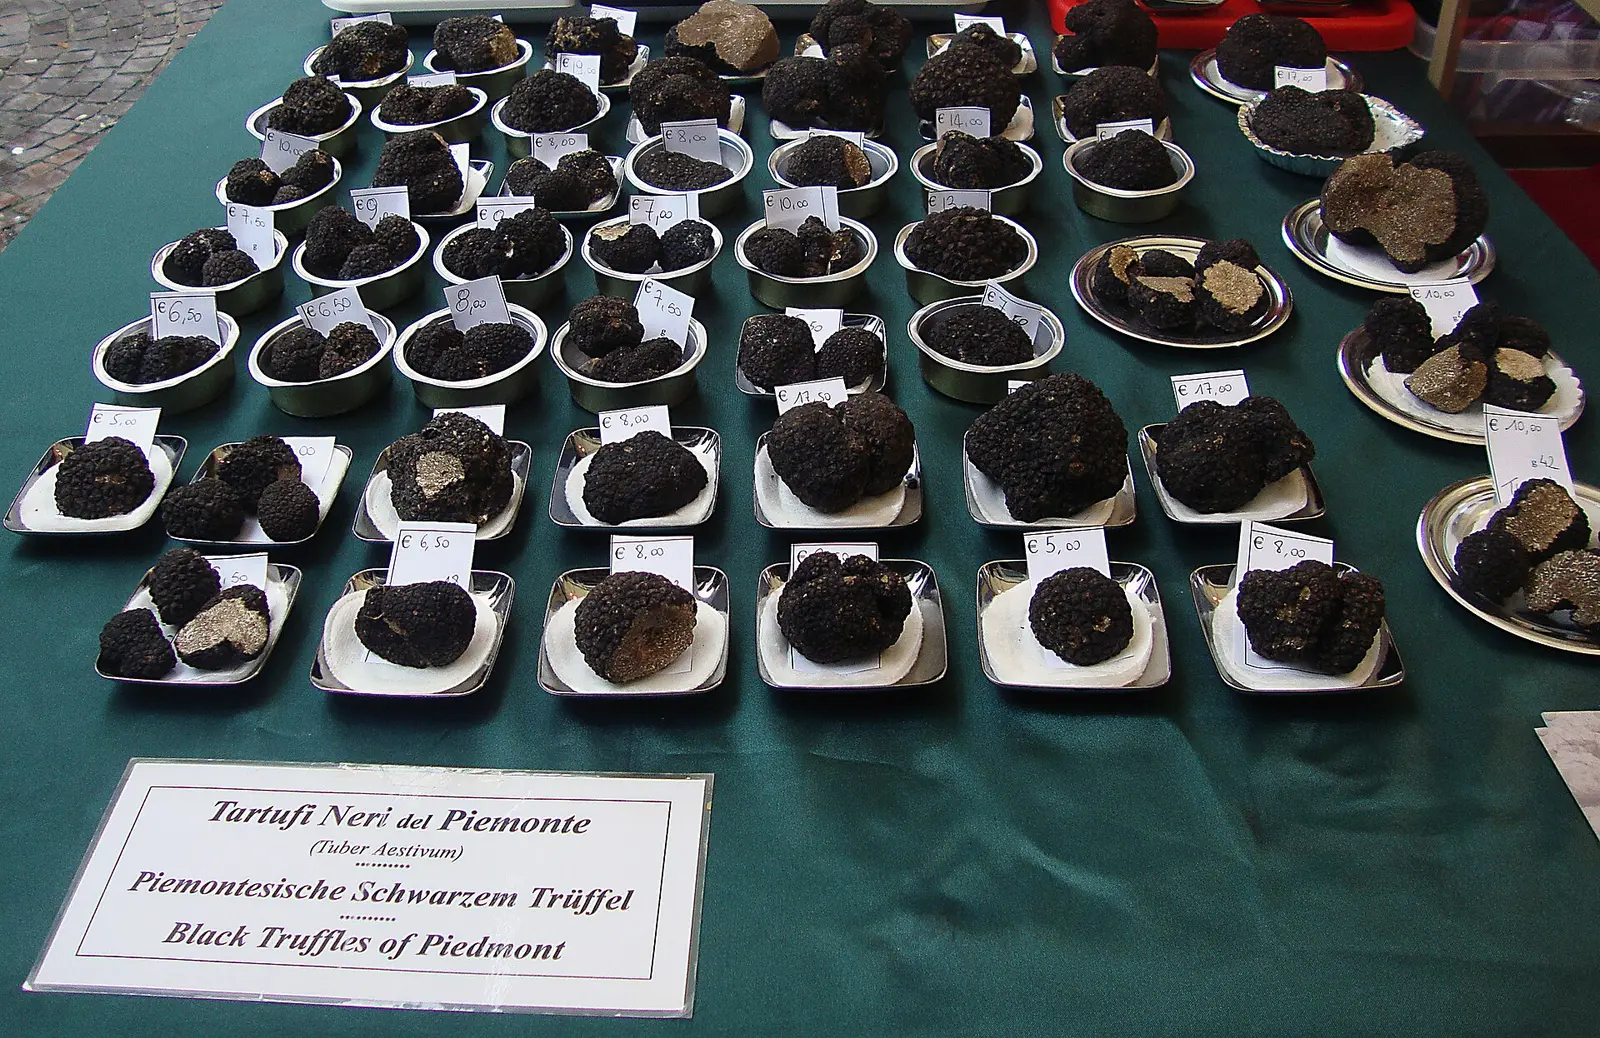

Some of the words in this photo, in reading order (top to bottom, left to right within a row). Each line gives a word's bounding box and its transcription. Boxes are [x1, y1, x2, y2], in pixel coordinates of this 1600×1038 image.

[563, 57, 570, 67] €
[1277, 70, 1284, 79] €
[1288, 69, 1313, 82] 17,00
[938, 113, 945, 124] €
[949, 114, 984, 128] 14,00
[267, 132, 275, 142] €
[536, 140, 543, 149] €
[549, 138, 576, 151] 8,00
[665, 130, 673, 140] €
[678, 130, 707, 144] 8,00
[356, 199, 364, 210] €
[766, 195, 774, 207] €
[779, 196, 809, 212] 10,00
[930, 195, 937, 207] €
[229, 206, 236, 218] €
[241, 208, 266, 229] 7,50
[480, 208, 488, 221] €
[632, 197, 640, 210] €
[643, 198, 673, 226] 7,00
[455, 288, 487, 315] 8,00
[645, 281, 654, 294] €
[654, 290, 682, 317] 7,50
[987, 290, 997, 302] €
[1412, 289, 1422, 299] €
[1424, 290, 1456, 301] 10,00
[157, 301, 166, 314] €
[168, 300, 203, 326] 6,50
[307, 305, 317, 318] €
[318, 297, 351, 318] 6,50
[778, 390, 788, 402] €
[792, 390, 831, 405] 17,50
[1178, 385, 1188, 396] €
[1193, 381, 1232, 397] 17,00
[94, 413, 103, 424] €
[108, 413, 137, 426] 5,00
[602, 416, 611, 429] €
[619, 413, 649, 428] 8,00
[1489, 418, 1499, 432] €
[1504, 420, 1542, 435] 10,00
[1539, 454, 1560, 471] 42
[401, 535, 412, 549] €
[419, 533, 450, 552] 6,50
[1028, 539, 1039, 554] €
[1044, 535, 1081, 555] 5,00
[1253, 536, 1264, 551] €
[1273, 539, 1306, 558] 8,00
[615, 546, 625, 561] €
[635, 543, 664, 561] 8,00
[208, 800, 318, 831] Tartufi
[318, 804, 393, 829] Neri
[396, 813, 434, 830] del
[437, 809, 592, 834] Piemonte
[309, 840, 371, 857] (Tuber
[371, 842, 465, 863] Aestivum)
[127, 870, 347, 901] Piemontesische
[350, 880, 519, 909] Schwarzem
[528, 887, 636, 916] Trüffel
[162, 921, 251, 948] Black
[256, 926, 372, 957] Truffles
[379, 932, 419, 961] of
[415, 933, 567, 961] Piedmont
